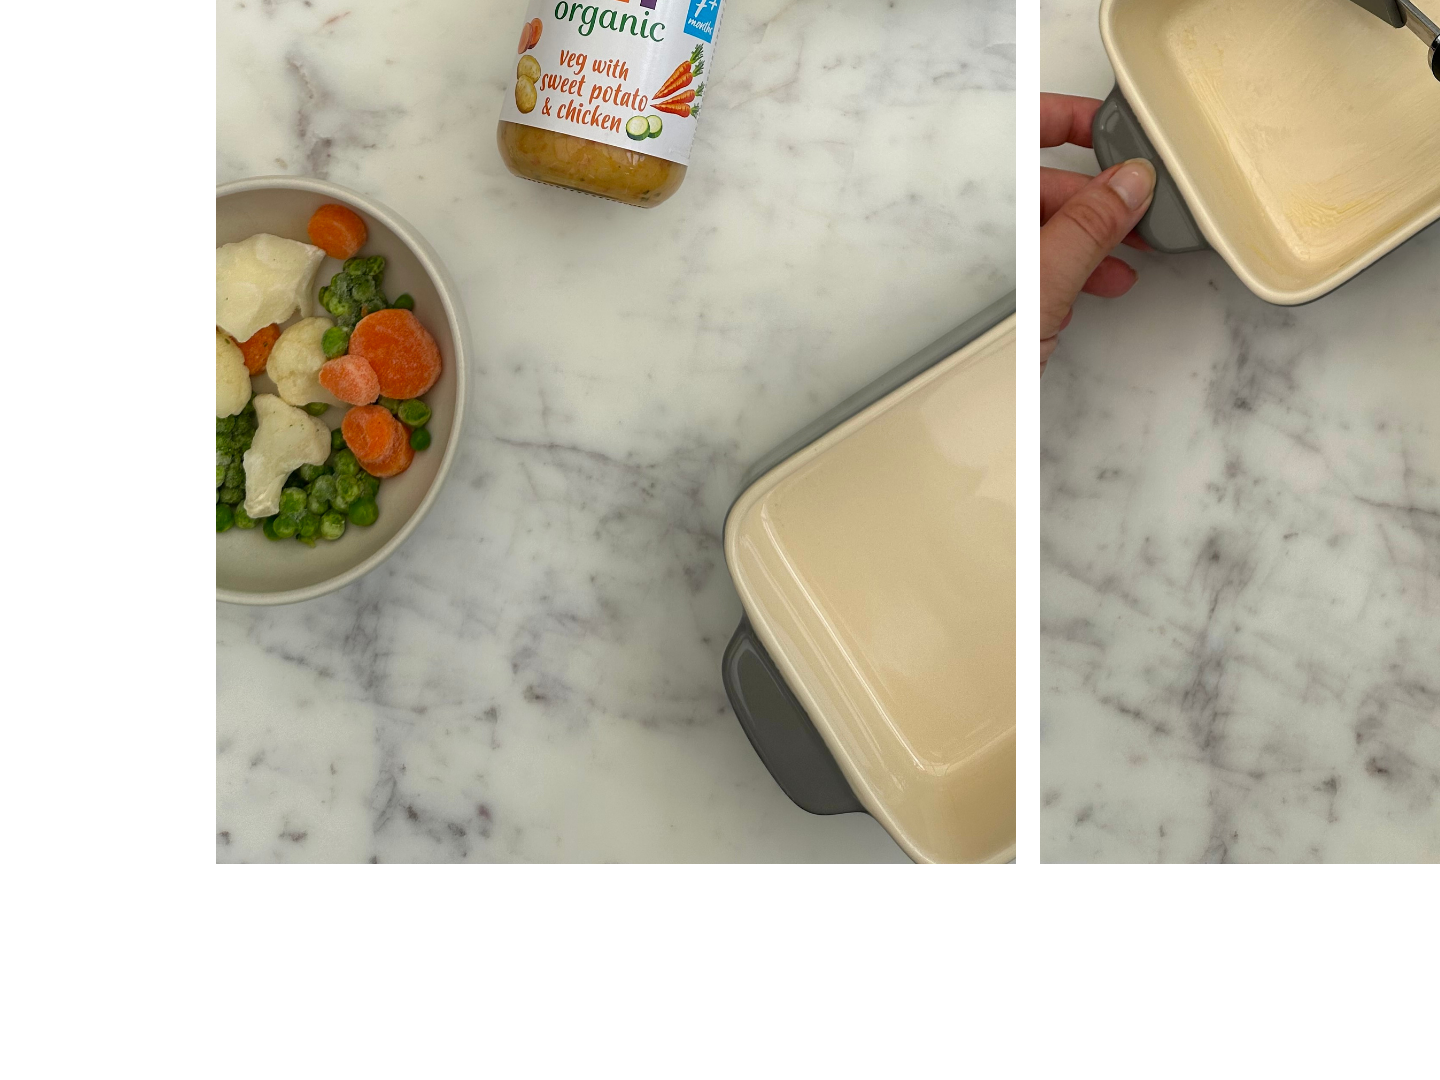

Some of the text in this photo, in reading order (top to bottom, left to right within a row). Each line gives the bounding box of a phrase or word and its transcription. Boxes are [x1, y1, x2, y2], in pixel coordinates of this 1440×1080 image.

[554, 1, 665, 42] organic
[688, 18, 713, 35] months
[560, 49, 629, 81] veg with
[540, 73, 648, 112] sweet potato
[541, 97, 622, 133] & chicken
